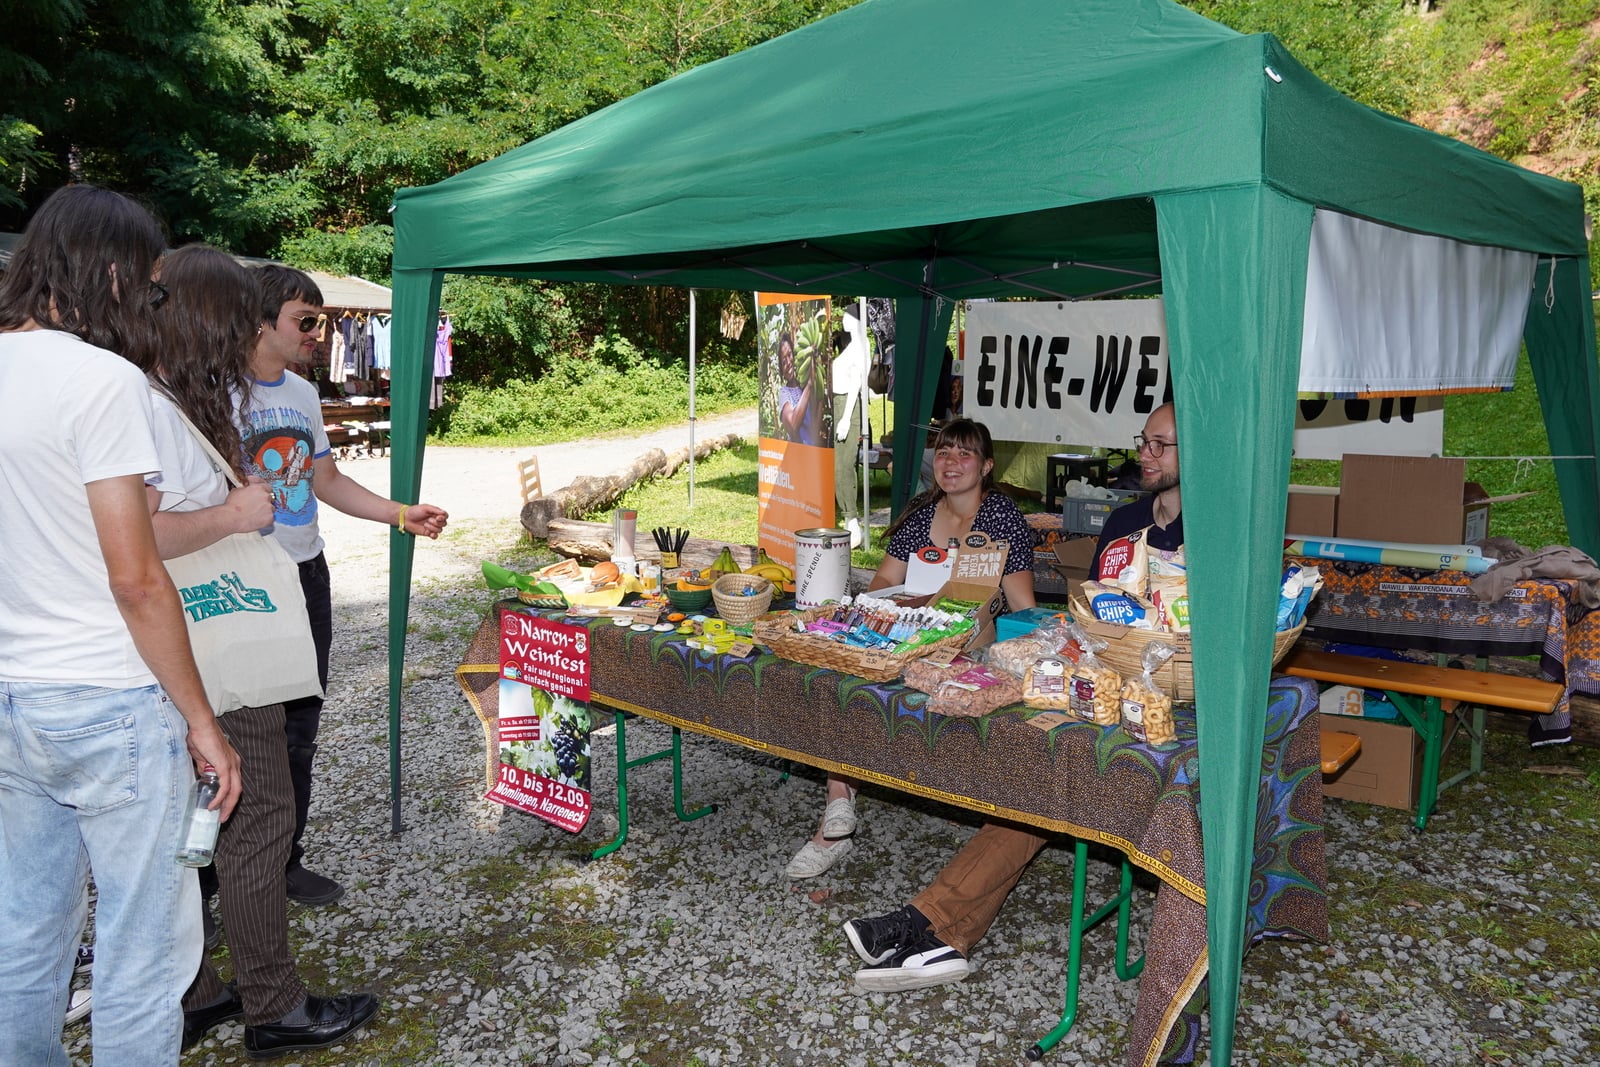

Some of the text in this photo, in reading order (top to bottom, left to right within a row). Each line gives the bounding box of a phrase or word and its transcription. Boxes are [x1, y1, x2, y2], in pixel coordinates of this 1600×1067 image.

[977, 335, 1174, 414] EINE-WE
[977, 562, 999, 577] FAIR
[1102, 566, 1118, 576] ROT
[1104, 553, 1128, 566] CHIPS
[800, 551, 822, 597] IHRE SPENDE
[1099, 605, 1134, 620] CHIPS
[519, 617, 574, 647] Narren-
[504, 638, 586, 674] Weinfest
[523, 663, 538, 674] Fair
[539, 668, 551, 678] und
[552, 672, 583, 687] regional
[523, 674, 550, 687] einfach
[550, 681, 574, 695] genial
[501, 766, 589, 810] 10. bis 12.09.
[494, 781, 538, 810] Mömlingen,
[539, 797, 585, 824] Narreneck
